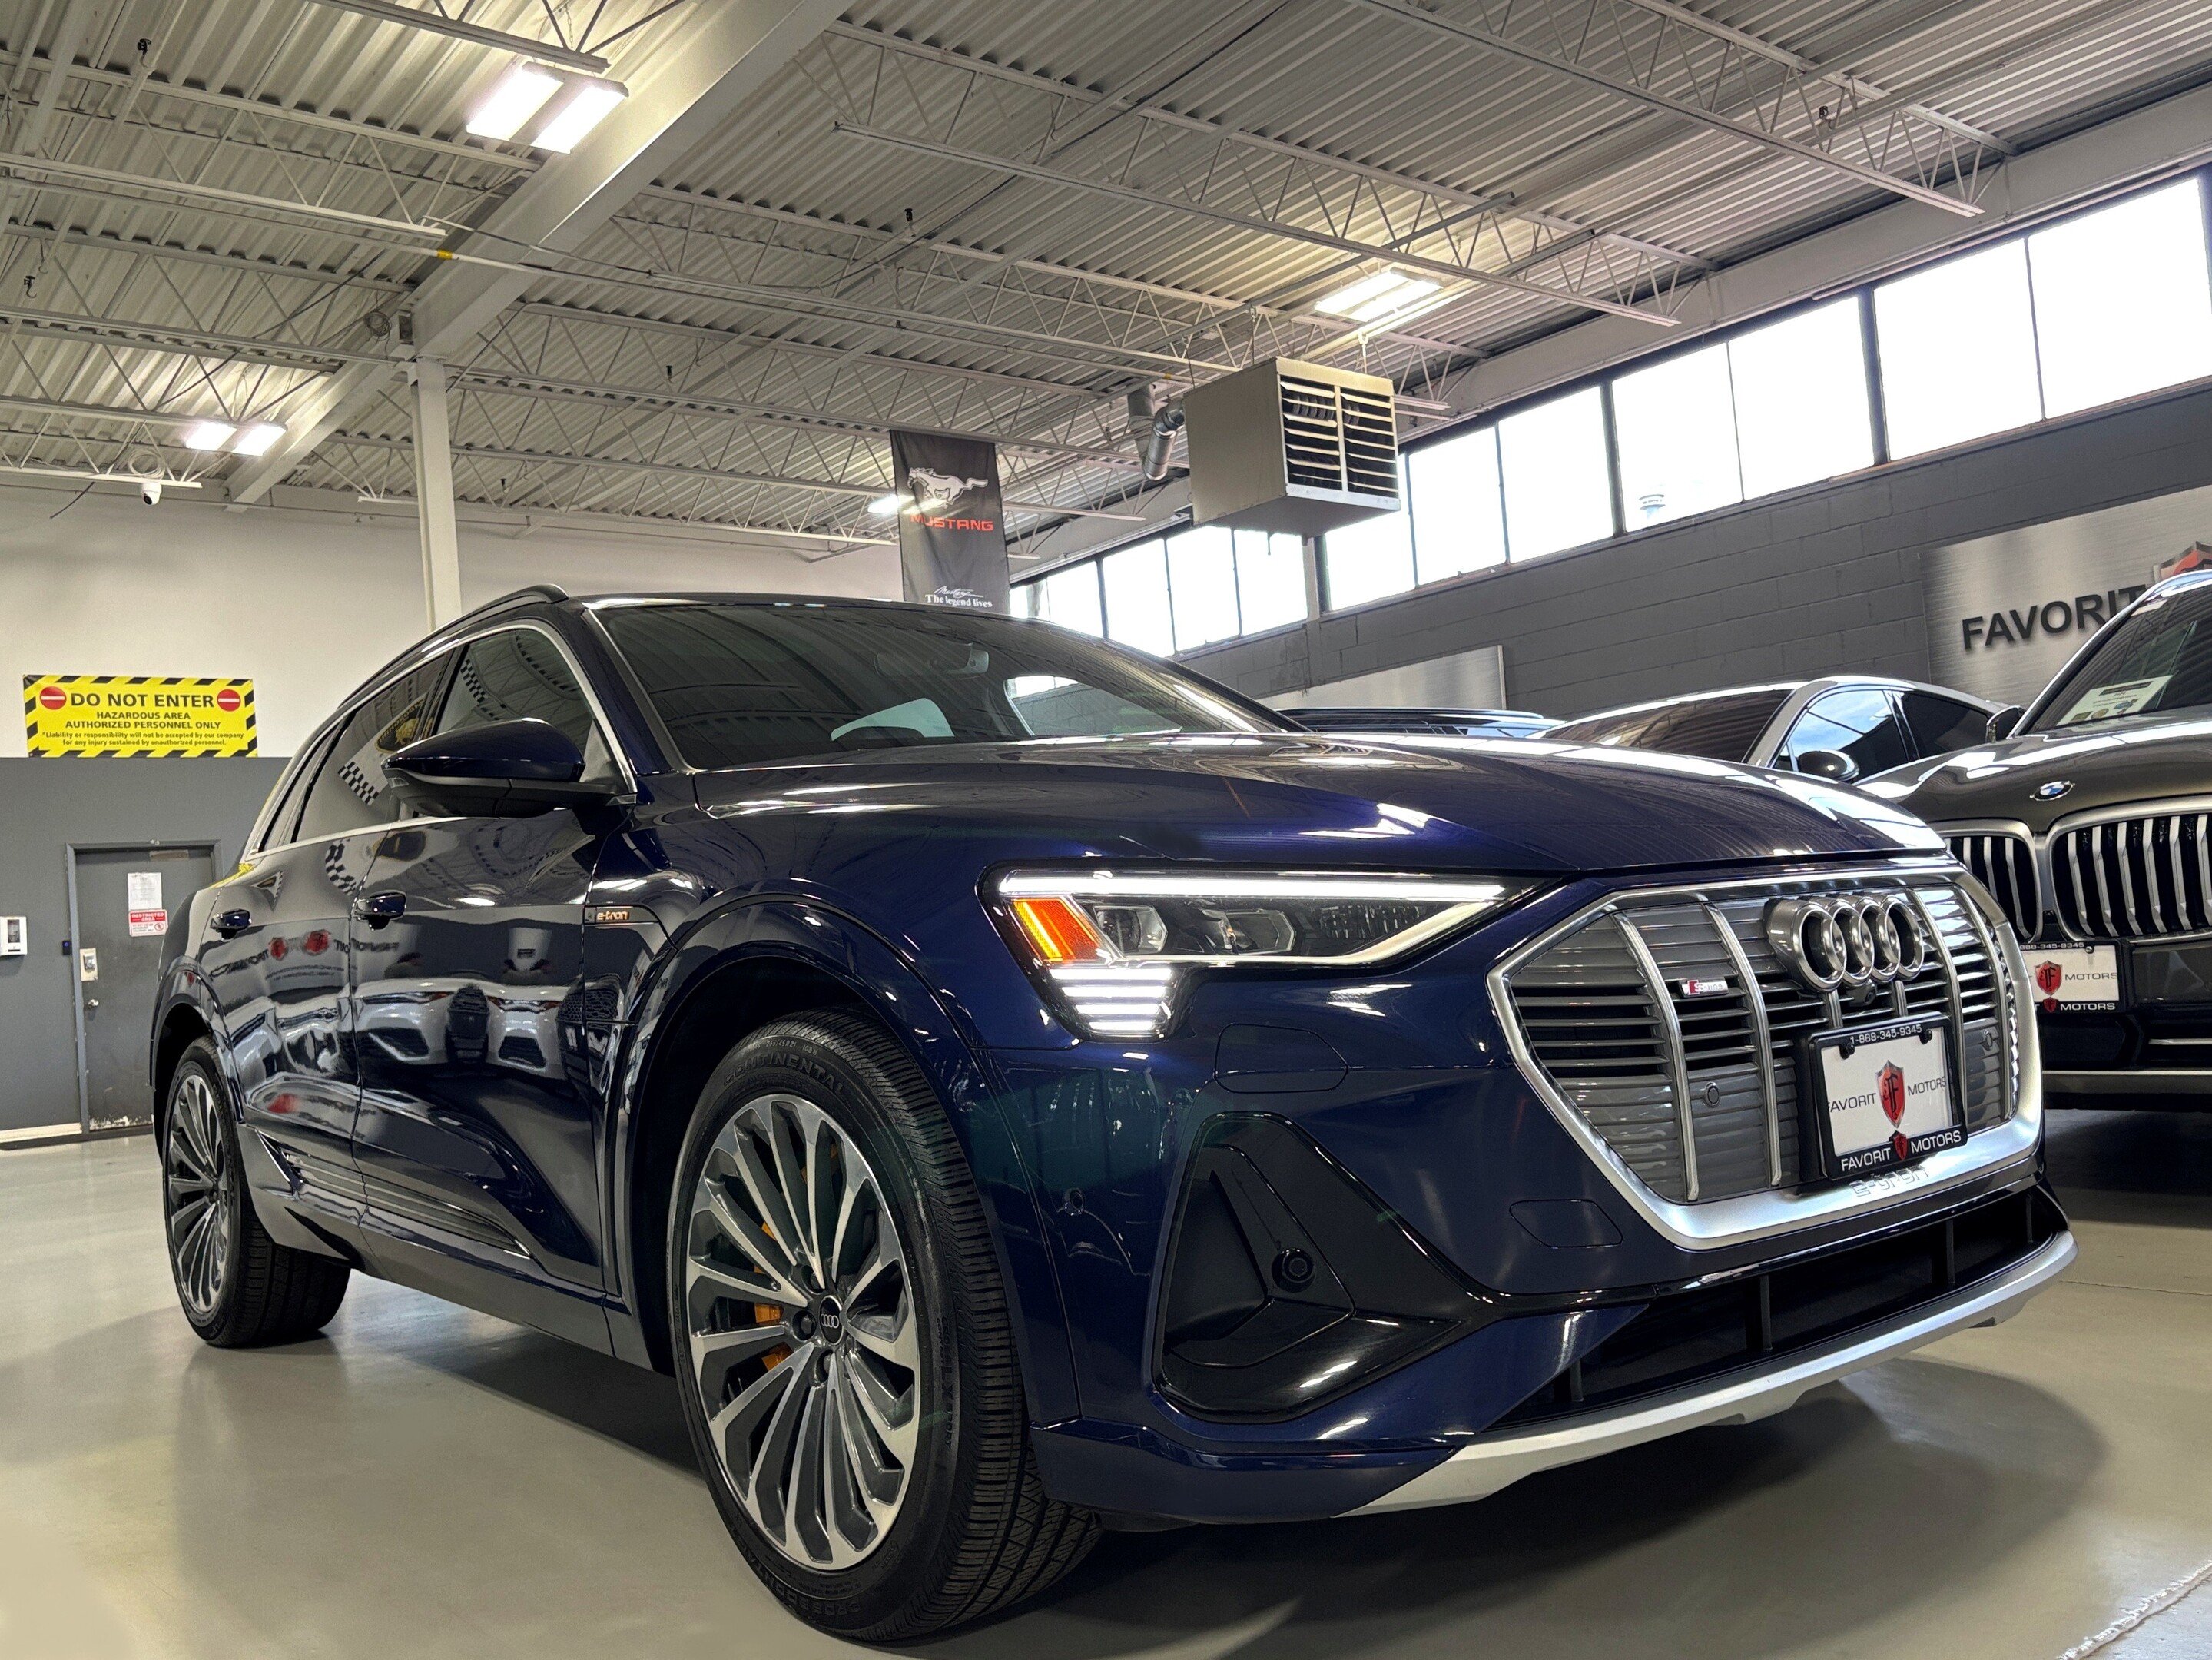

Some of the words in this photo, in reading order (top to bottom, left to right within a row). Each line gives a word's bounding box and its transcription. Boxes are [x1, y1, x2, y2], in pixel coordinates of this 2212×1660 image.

[910, 513, 993, 531] MUSTANG
[924, 594, 944, 603] The
[945, 596, 972, 607] legend
[972, 599, 993, 608] lives
[71, 693, 101, 707] DO
[108, 693, 148, 707] NOT
[154, 694, 214, 708] ENTER
[134, 721, 193, 729] PERSONNEL
[597, 911, 628, 921] e-tron
[2019, 942, 2084, 951] 888-345-9345
[2064, 972, 2118, 981] MOTORS
[2060, 1002, 2116, 1011] MOTORS
[1849, 1024, 1922, 1045] 1-888-345-9345
[723, 1051, 844, 1094] CONTINENTAL
[1907, 1076, 1947, 1097] MOTORS
[1841, 1147, 1892, 1172] FAVORIT
[1910, 1130, 1962, 1154] MOTORS
